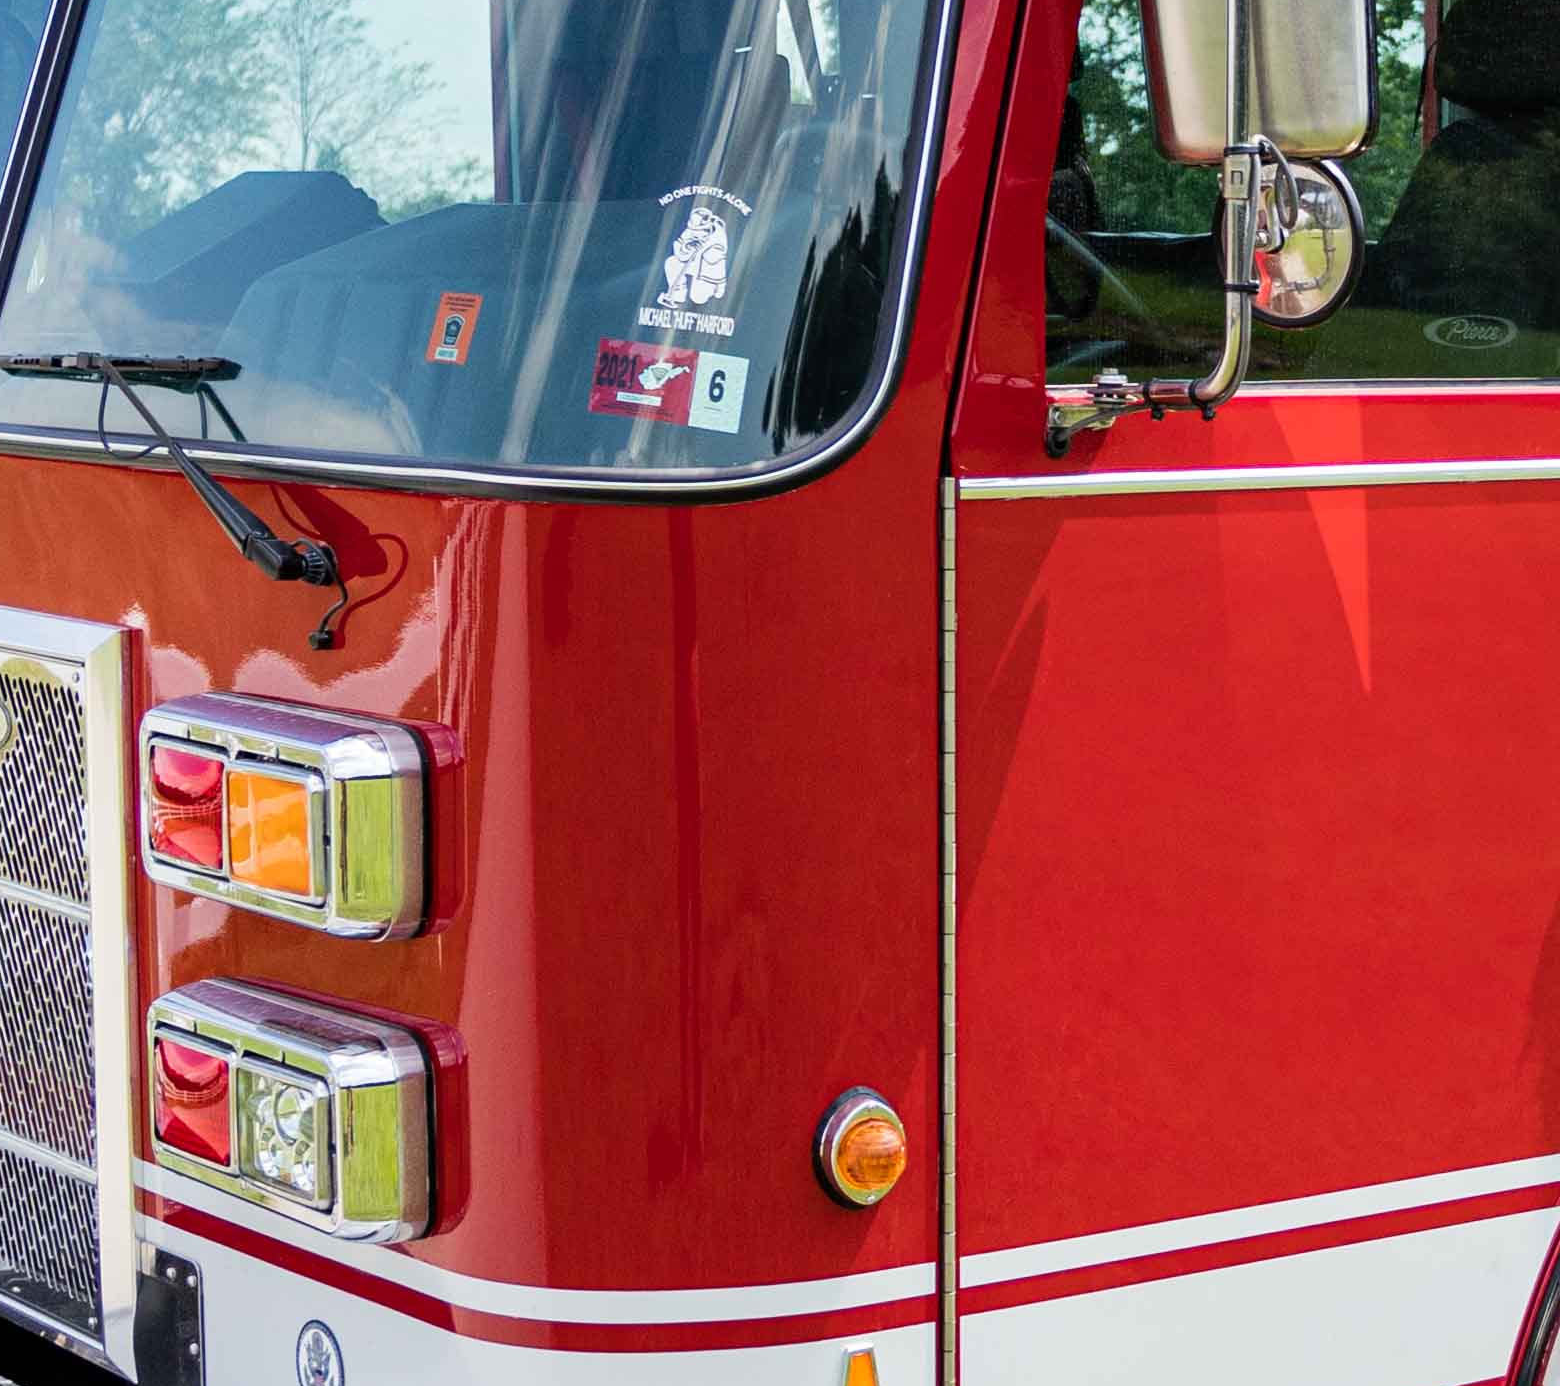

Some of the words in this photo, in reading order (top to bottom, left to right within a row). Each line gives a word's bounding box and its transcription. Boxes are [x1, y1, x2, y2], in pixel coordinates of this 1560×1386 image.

[658, 193, 673, 206] NO
[673, 187, 692, 199] ONE
[692, 185, 724, 198] FIGHTS
[722, 193, 752, 216] ALONE
[638, 307, 672, 328] MICHAEL
[1445, 317, 1501, 342] Pierce
[596, 352, 639, 389] 2021
[708, 369, 727, 403] 6
